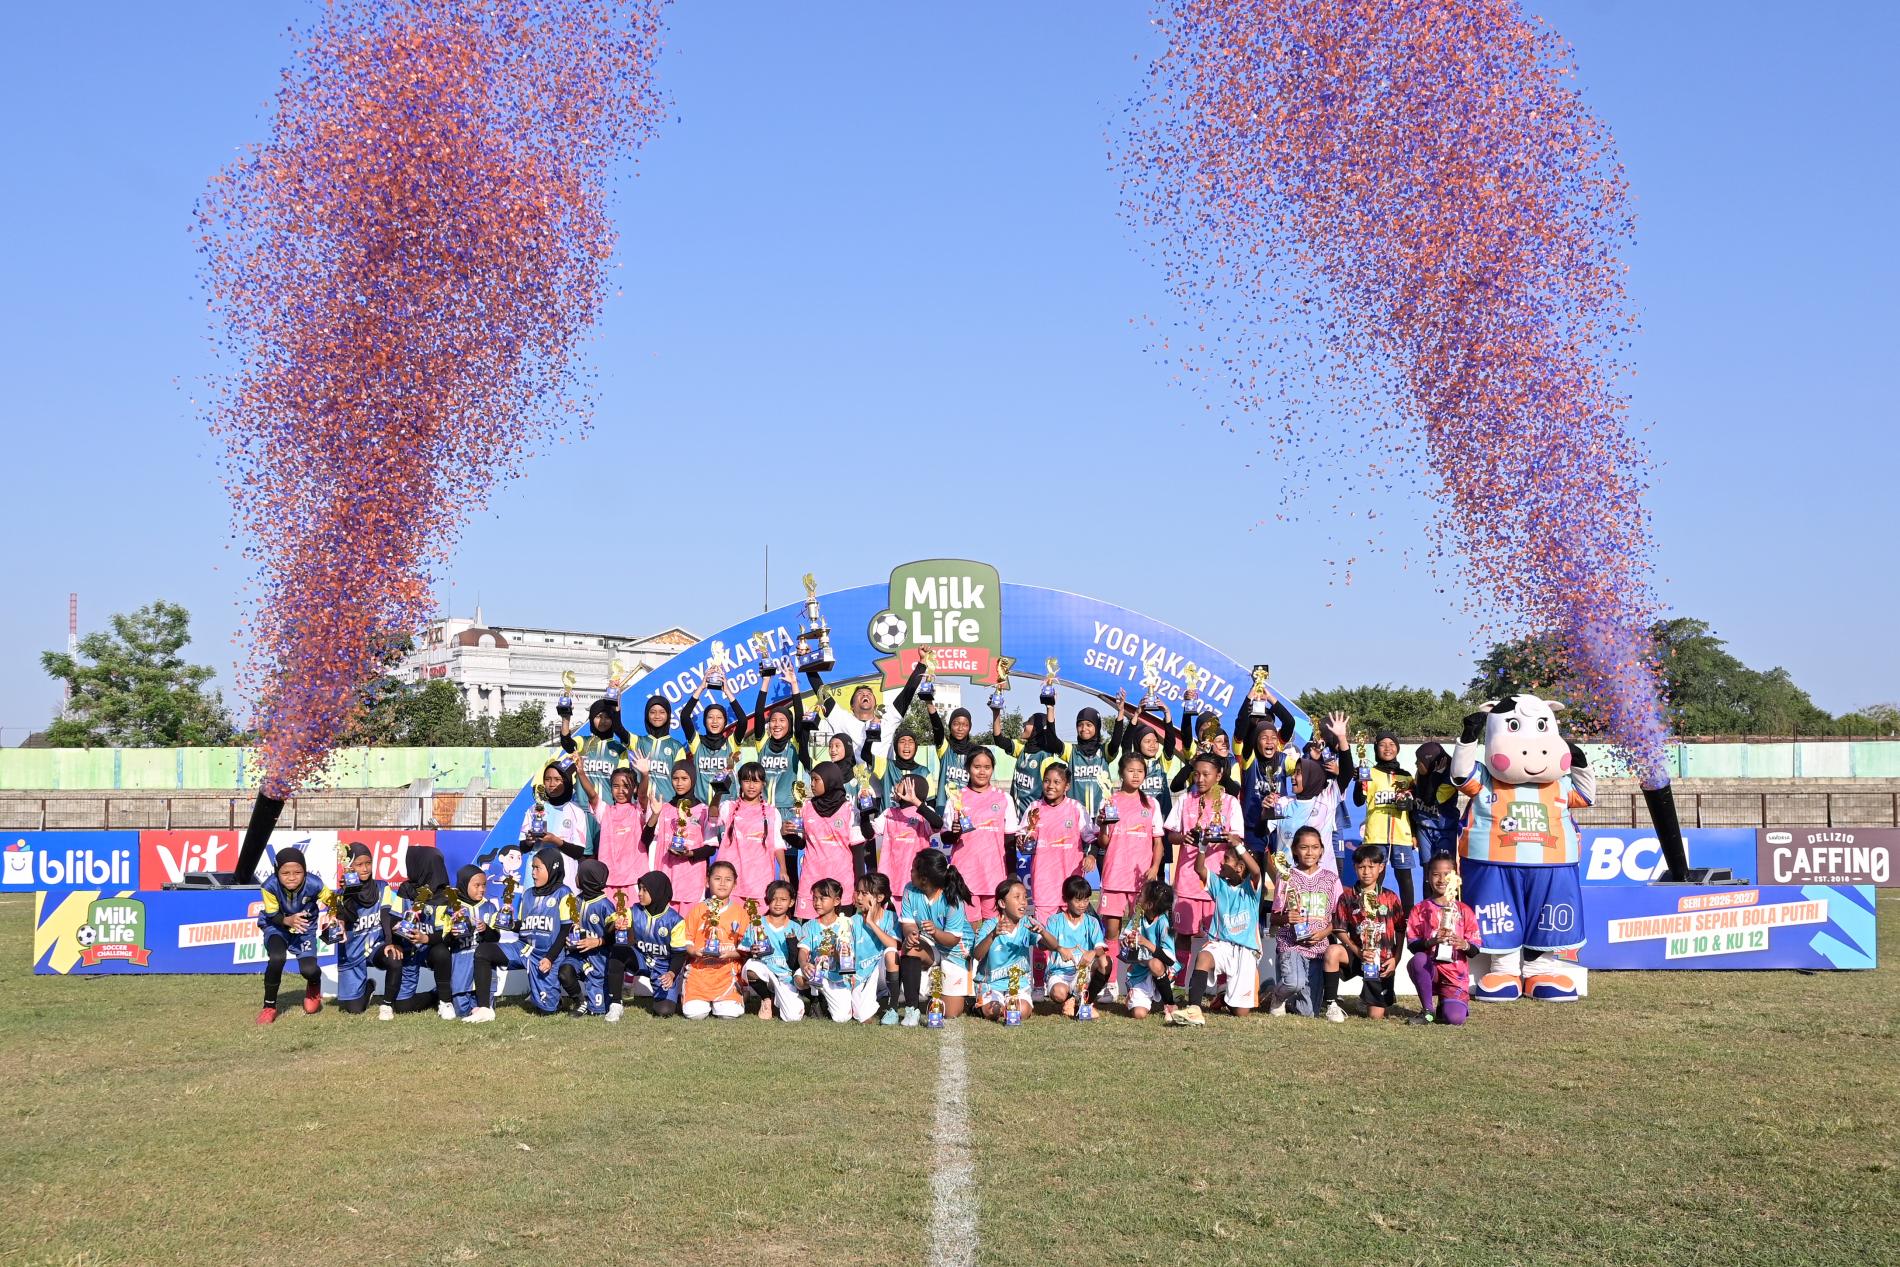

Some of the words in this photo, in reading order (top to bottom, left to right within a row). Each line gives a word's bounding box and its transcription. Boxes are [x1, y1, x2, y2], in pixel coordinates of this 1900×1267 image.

[904, 576, 986, 610] Milk
[912, 611, 980, 644] Life
[1083, 648, 1125, 676] SERI
[1128, 665, 1138, 681] 1
[704, 689, 716, 705] 1
[1375, 790, 1397, 804] SAP
[1485, 793, 1498, 803] 10
[1511, 804, 1545, 819] Milk
[1517, 817, 1547, 832] Life
[1807, 832, 1855, 844] DELIZIO
[39, 850, 130, 884] blibli
[156, 835, 229, 884] Vit
[1773, 847, 1890, 883] CAFFINO
[1683, 898, 1701, 909] SERI
[1703, 898, 1708, 907] 1
[1709, 892, 1755, 906] 2026-2027
[95, 907, 138, 924] Milk
[1475, 901, 1513, 920] Milk
[1538, 903, 1574, 932] 10
[1482, 917, 1514, 935] Life
[1618, 916, 1691, 938] TURNAMEN
[1695, 911, 1738, 931] SEPAK
[1742, 907, 1776, 926] BOLA
[1781, 903, 1819, 922] PUTRI
[98, 925, 135, 943] Life
[188, 922, 260, 944] TURNAMEN
[238, 943, 256, 960] KU
[1670, 938, 1688, 955] KU
[1694, 936, 1708, 953] 10
[1712, 935, 1721, 951] &
[1726, 932, 1744, 950] KU
[1748, 931, 1763, 947] 12
